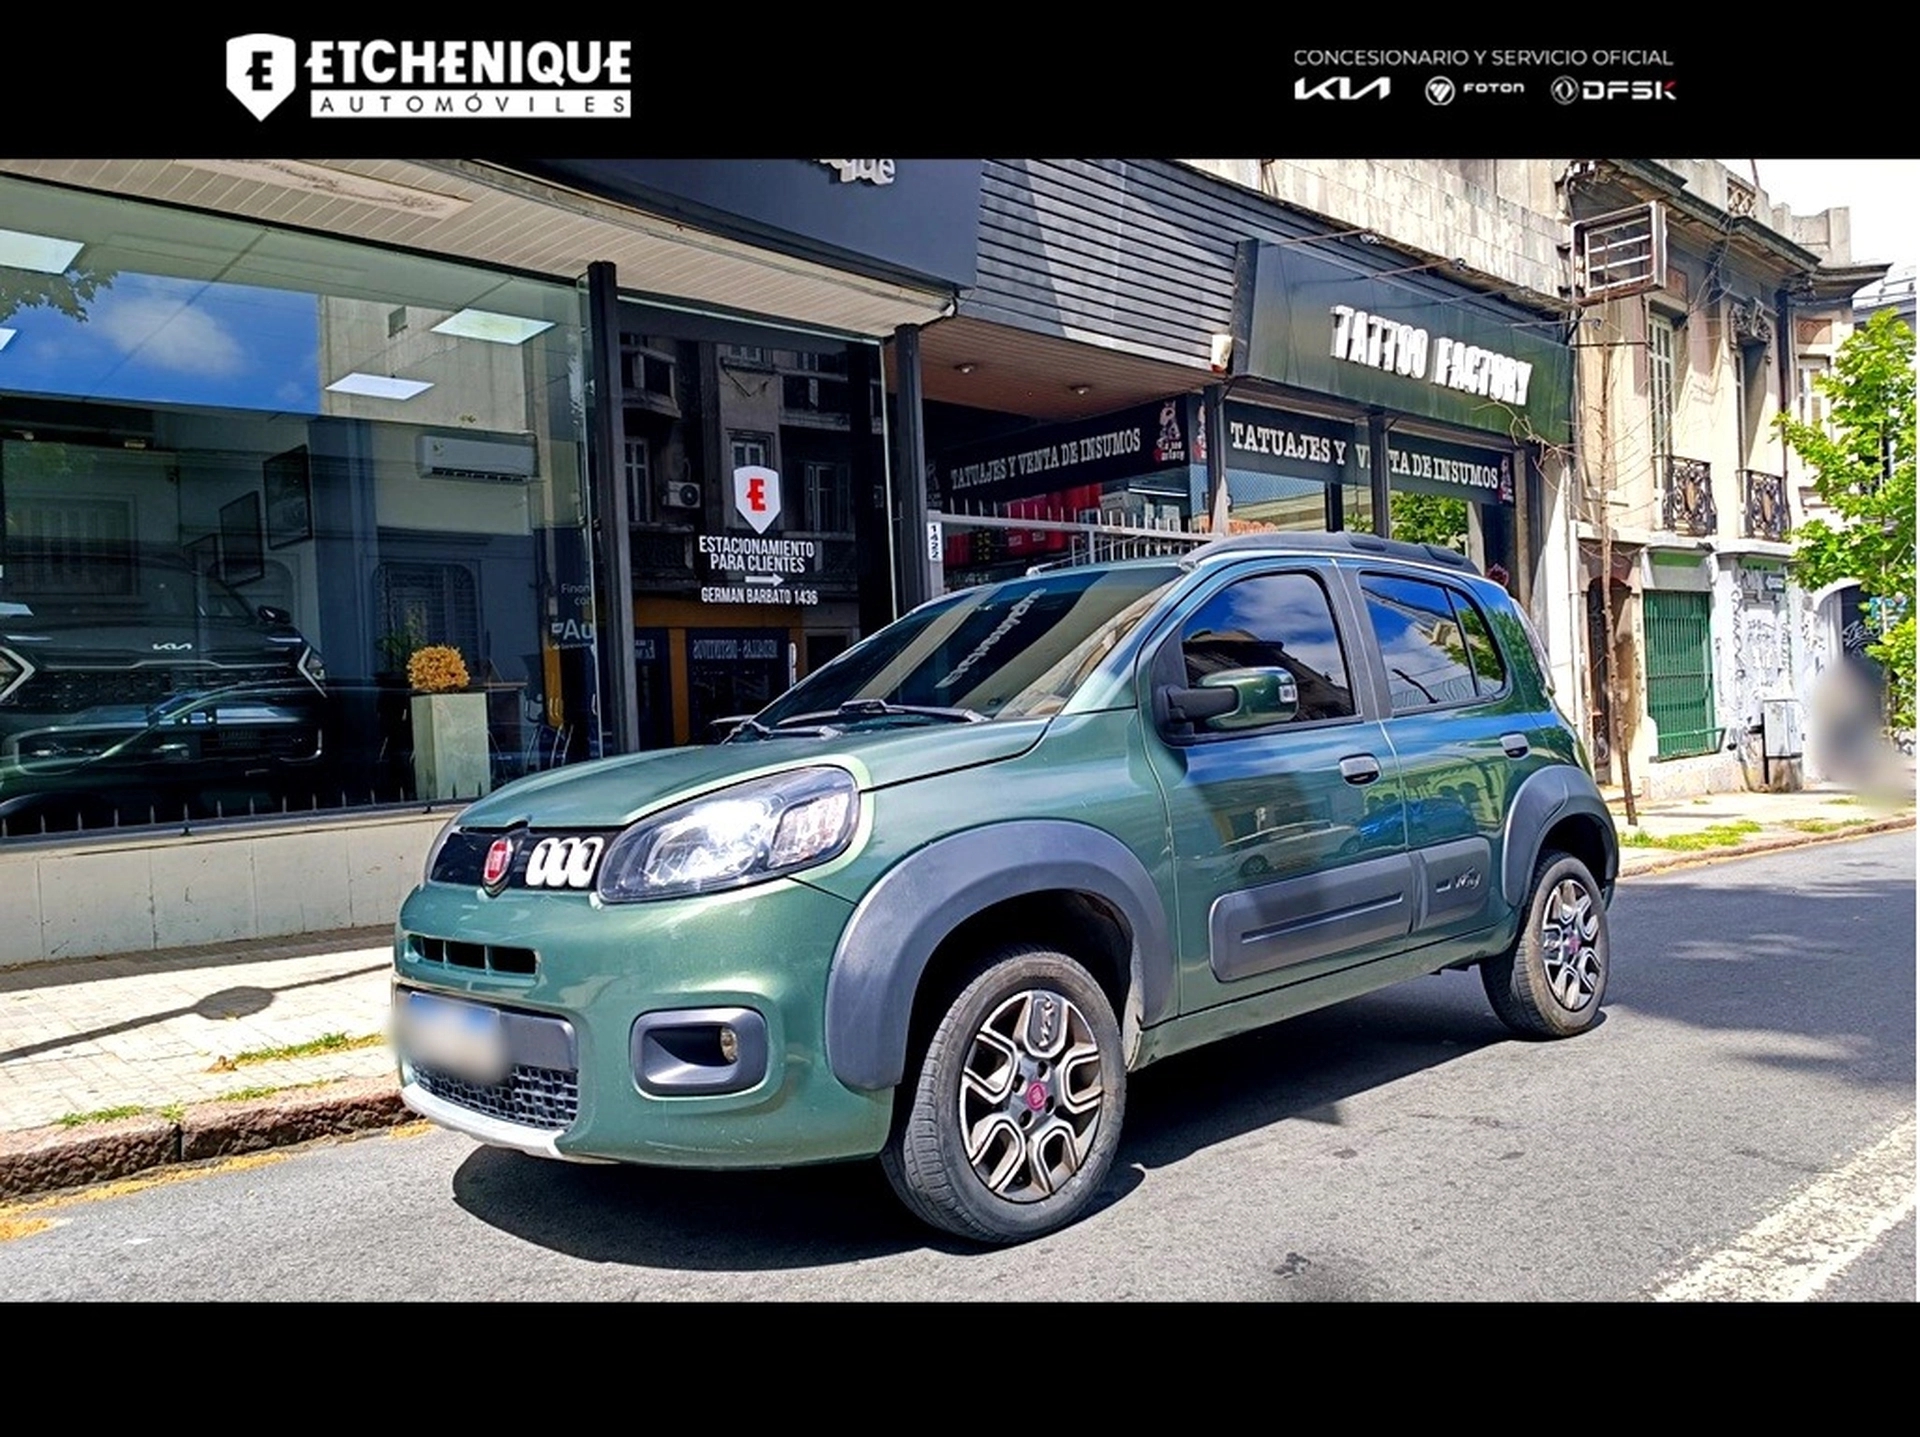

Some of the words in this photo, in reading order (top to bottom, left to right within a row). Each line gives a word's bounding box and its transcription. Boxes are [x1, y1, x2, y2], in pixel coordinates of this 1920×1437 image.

[1330, 305, 1428, 379] TATTOO
[1430, 337, 1532, 405] FACTORY
[950, 456, 1007, 490] TATUAJES
[1007, 455, 1017, 478] Y
[1017, 445, 1059, 476] VENTA
[1060, 441, 1079, 467] DE
[1080, 428, 1141, 463] INSUMOS
[1230, 421, 1331, 463] TATUAJES
[1333, 440, 1346, 466] Y
[1412, 453, 1432, 479] DE
[1433, 457, 1498, 489] INSUMOS
[699, 535, 815, 558] ESTACIONAMIENTO
[710, 553, 746, 571] PARA
[747, 555, 806, 573] CLIENTES
[701, 587, 745, 603] GERMAN
[746, 588, 792, 604] BARBATO
[794, 590, 818, 605] 1436
